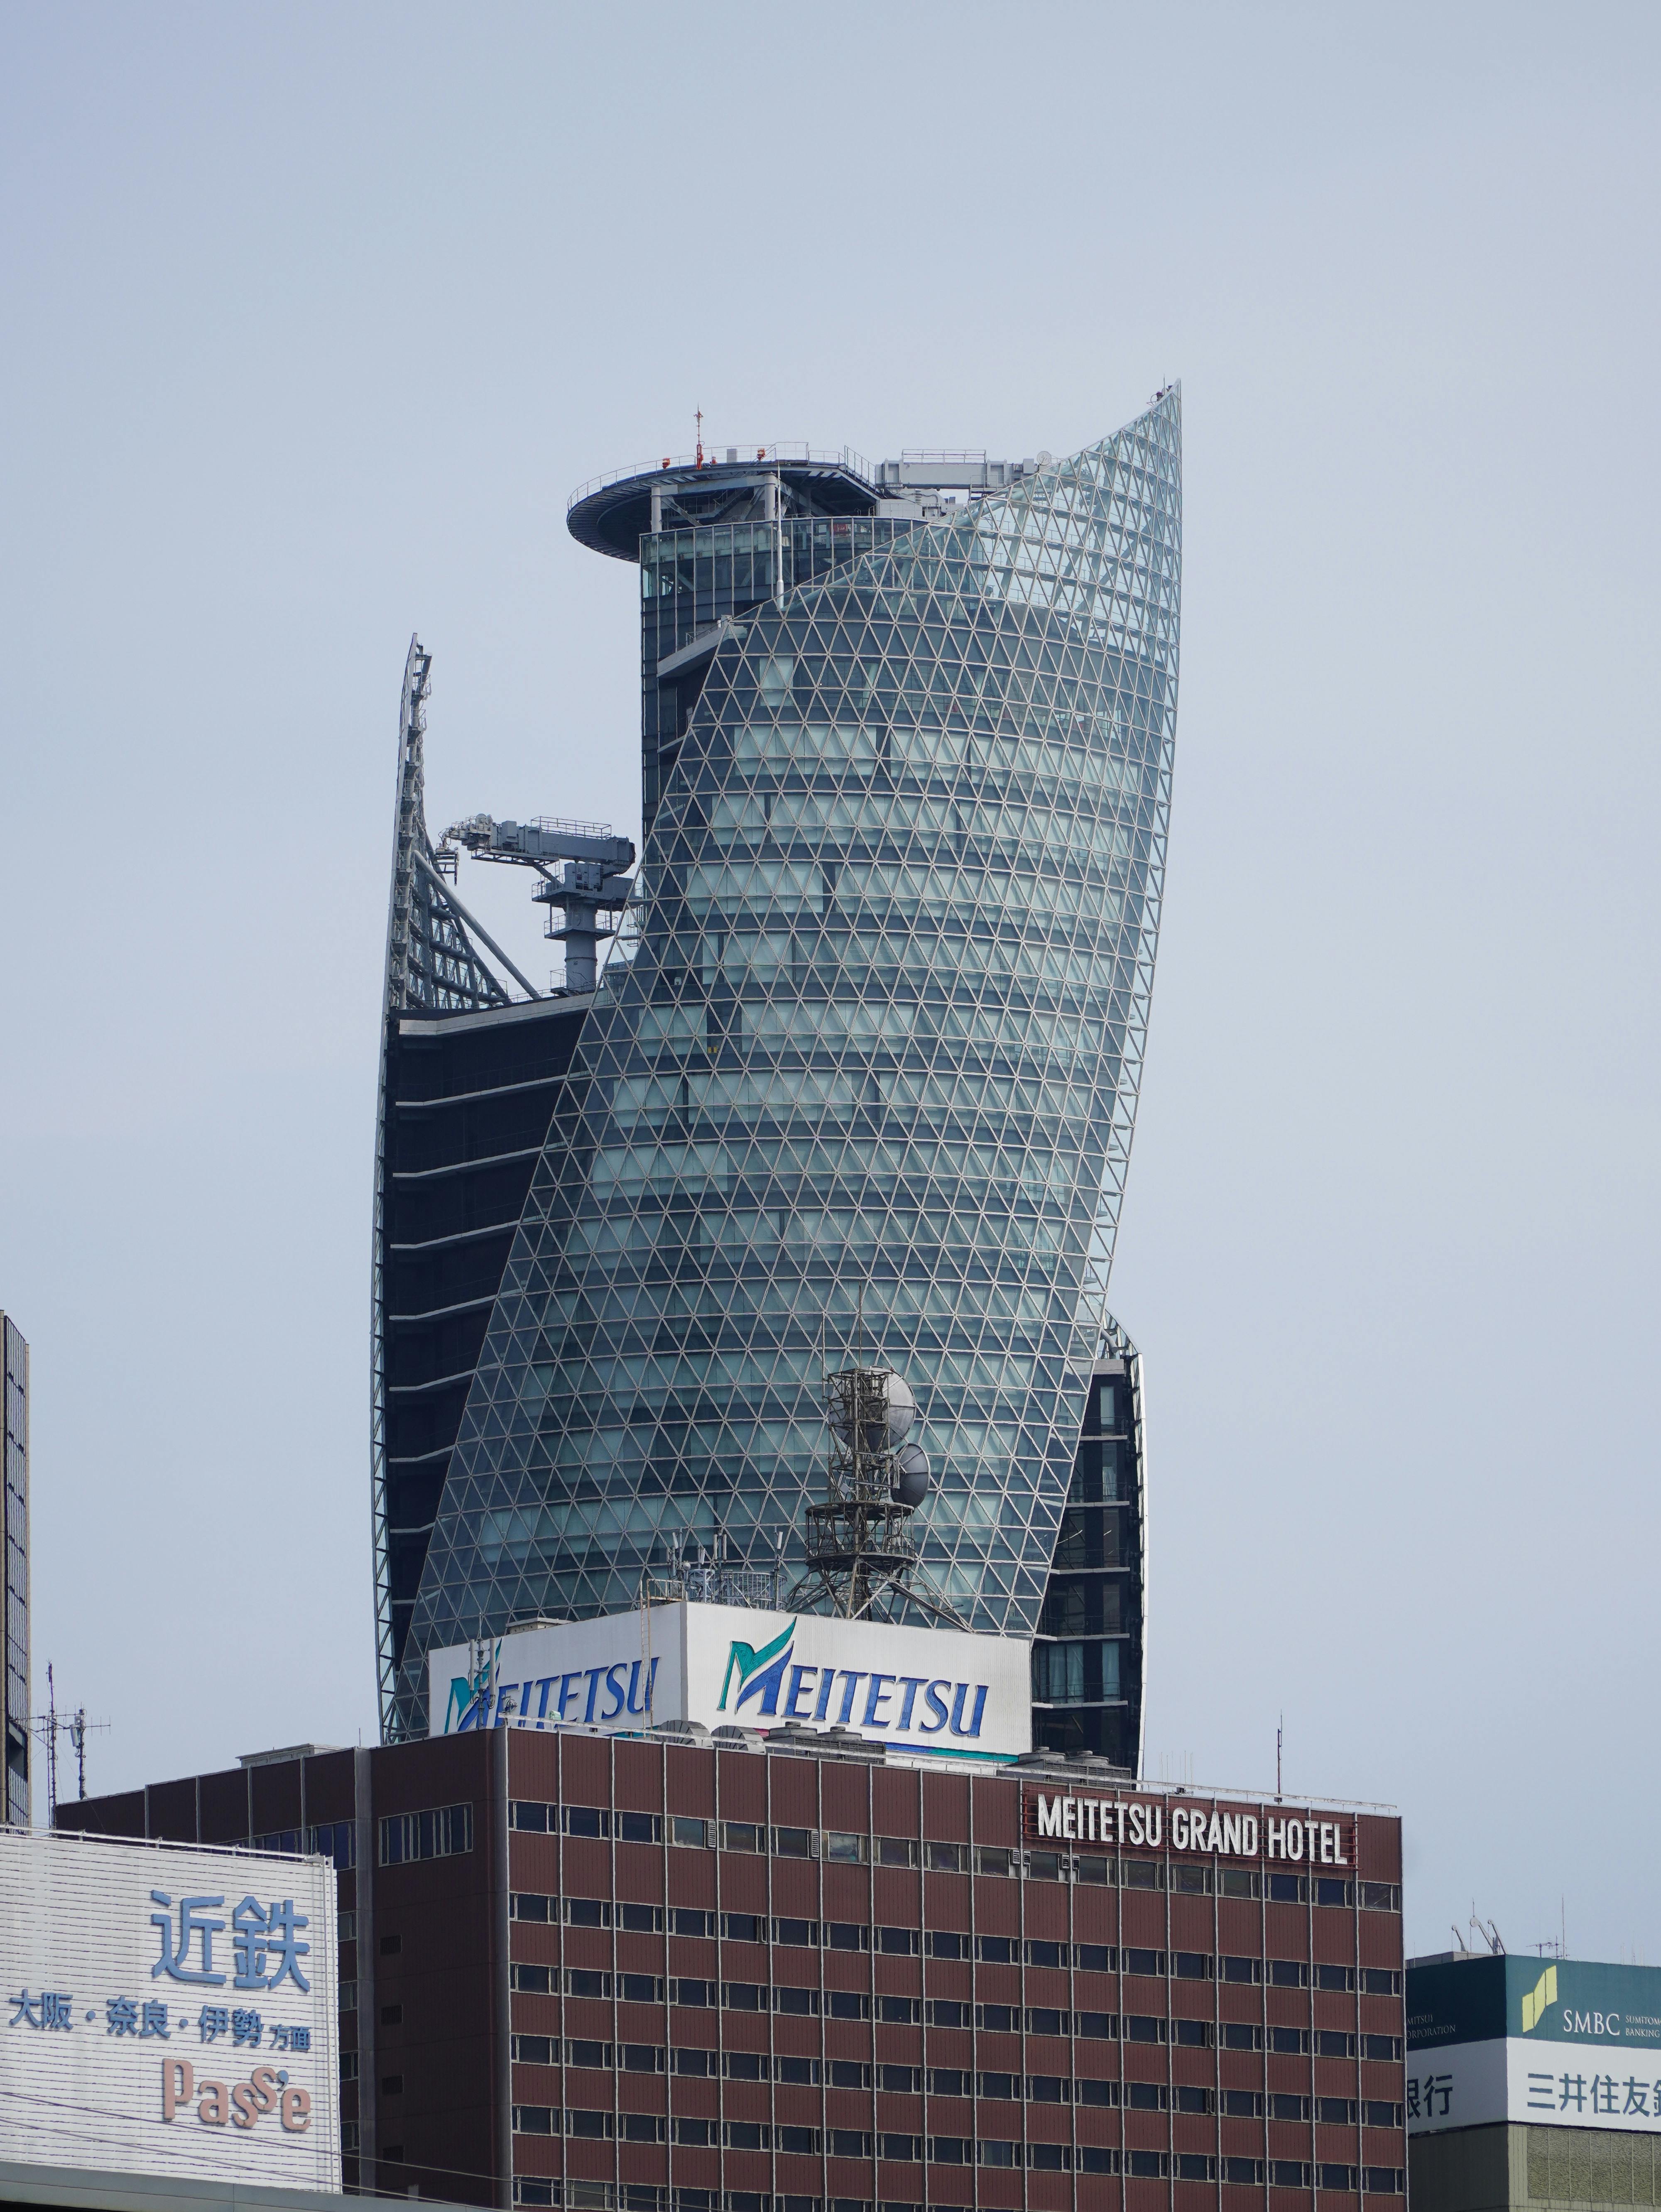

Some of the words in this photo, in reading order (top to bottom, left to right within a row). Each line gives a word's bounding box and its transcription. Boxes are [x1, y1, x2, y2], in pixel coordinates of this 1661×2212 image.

[444, 1637, 661, 1734] MEITETSU
[716, 1616, 989, 1737] MEITETSU
[1037, 1794, 1162, 1847] MEITETSU
[1172, 1807, 1258, 1857] GRAND
[1268, 1817, 1347, 1865] HOTEL
[150, 1889, 310, 1992] 近鉄
[1407, 2014, 1433, 2025] MITSUI
[1563, 2009, 1620, 2036] SMBC
[1625, 2015, 1661, 2026] SUMITOM
[1626, 2028, 1660, 2038] BANKING
[1527, 2073, 1661, 2117] 三井住友
